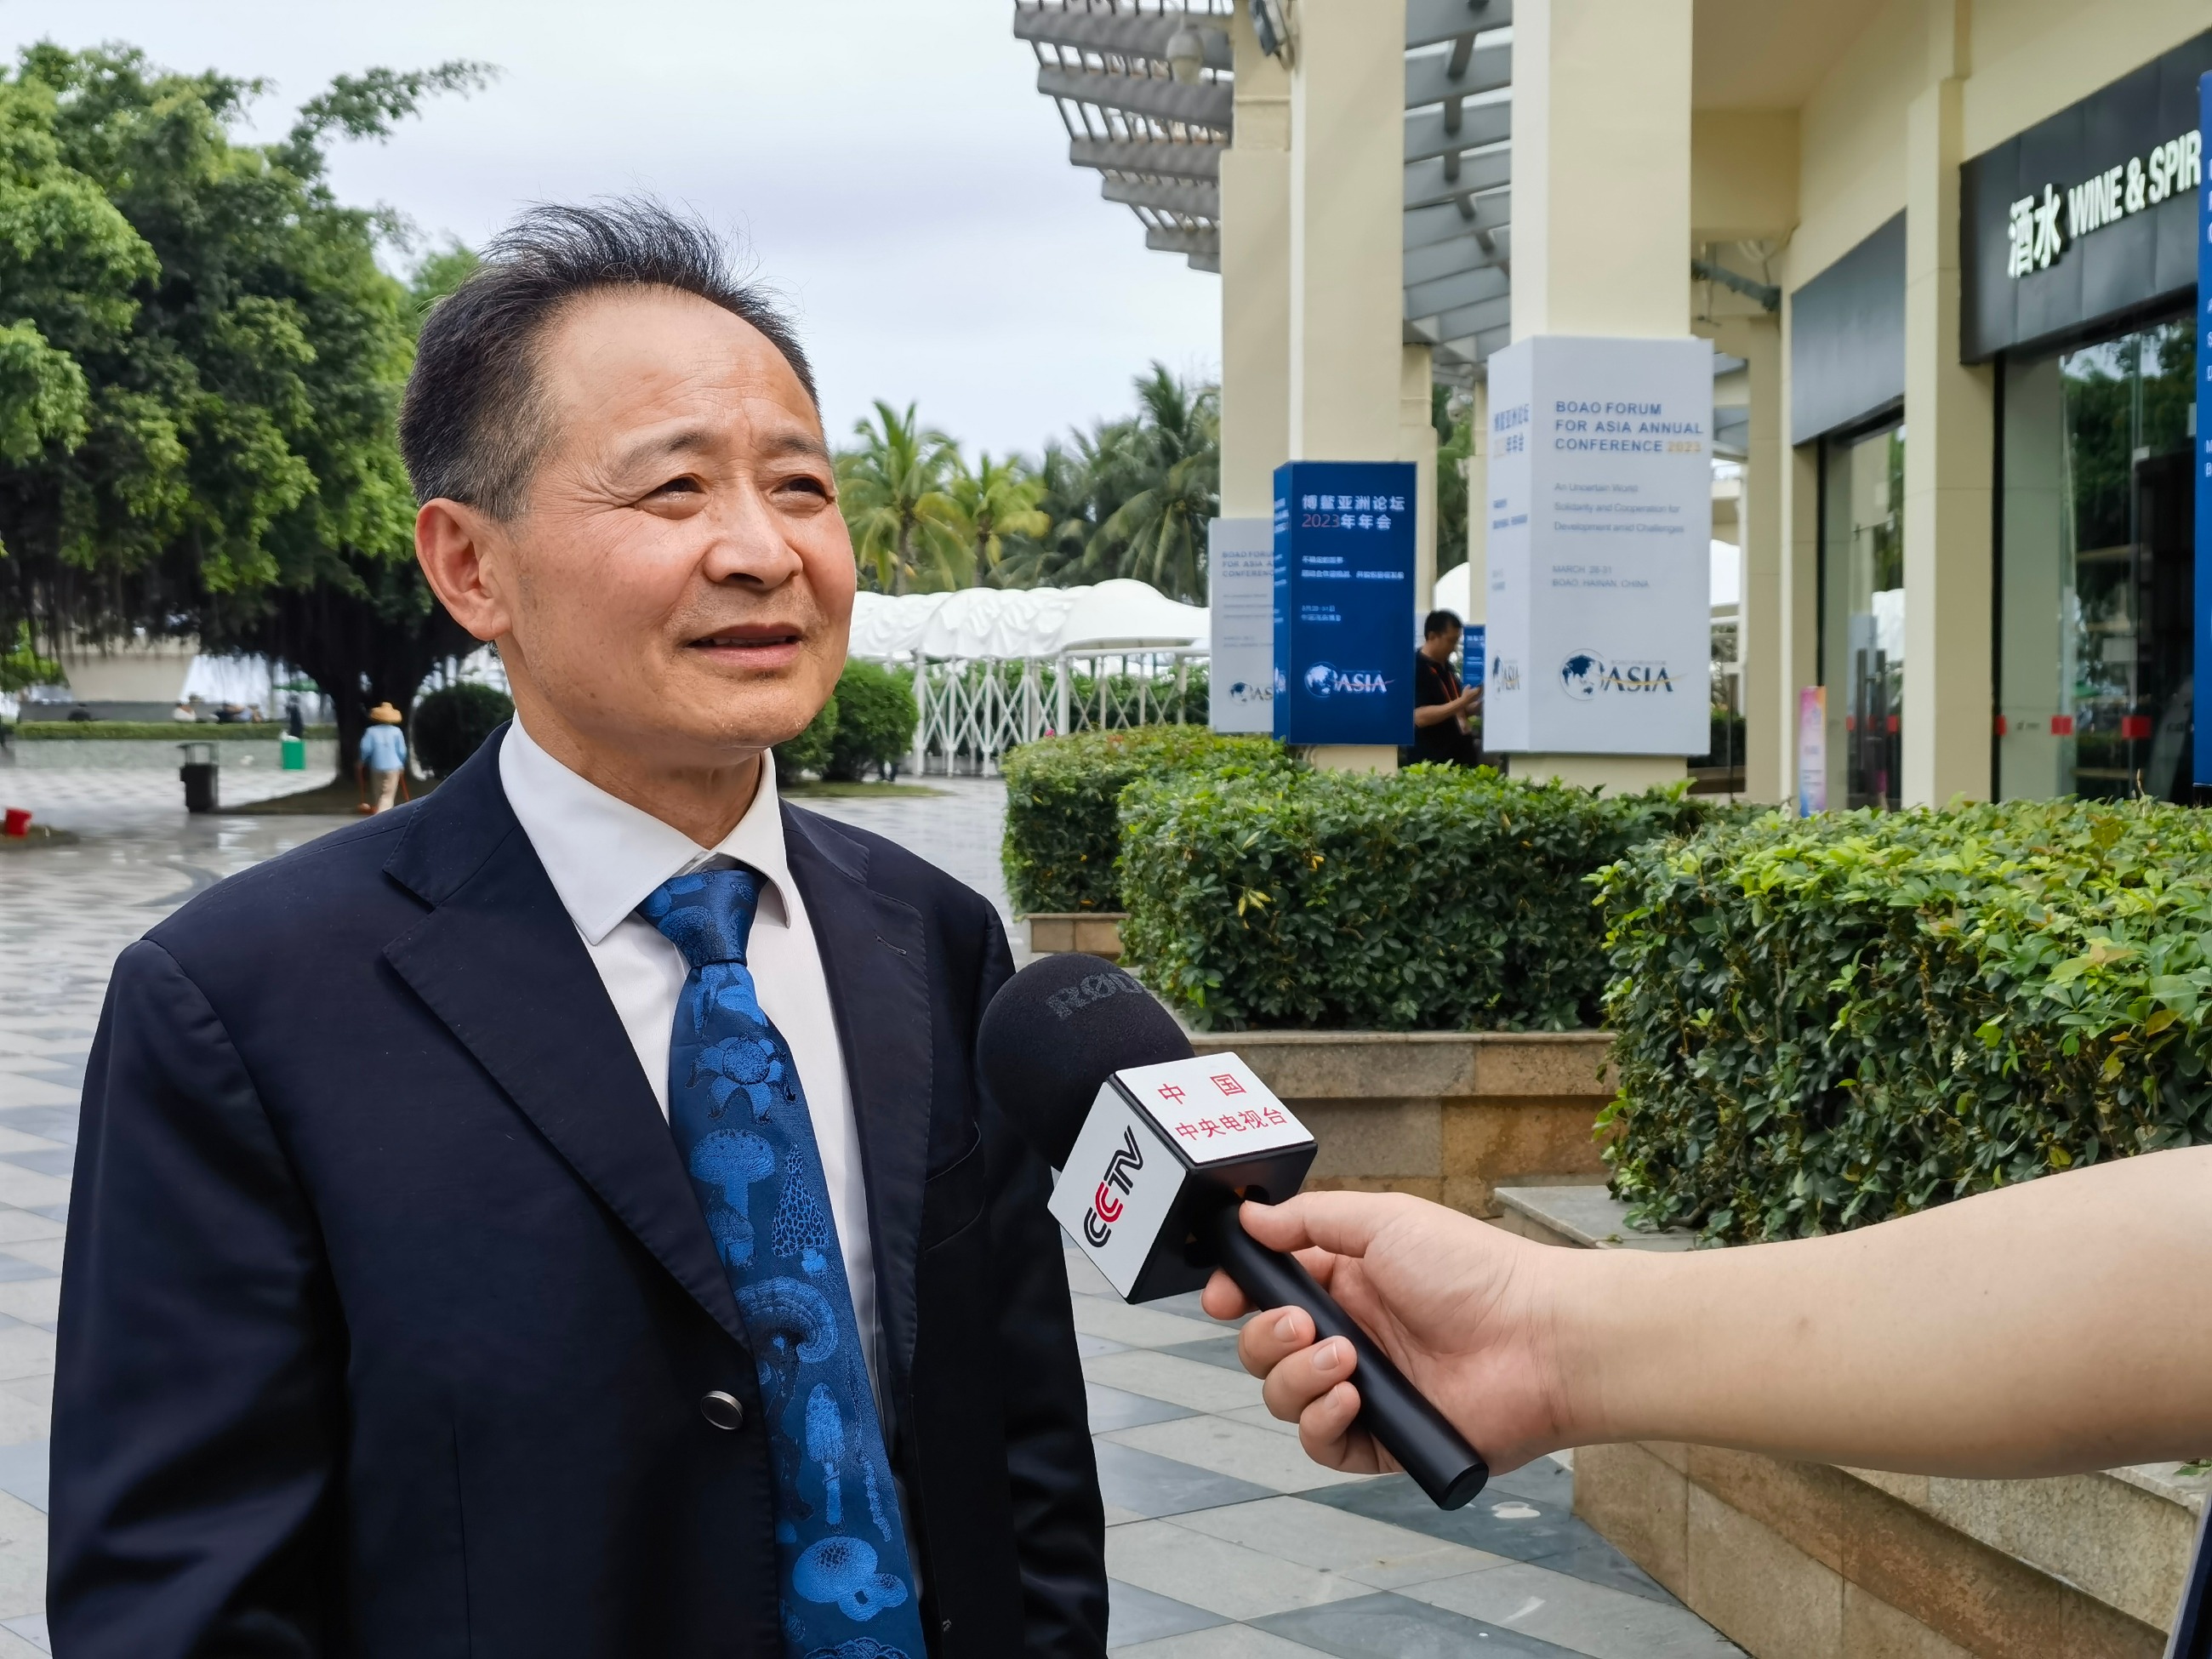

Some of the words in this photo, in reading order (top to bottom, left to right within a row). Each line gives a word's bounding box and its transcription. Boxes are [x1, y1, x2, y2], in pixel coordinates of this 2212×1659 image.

[2068, 164, 2124, 239] WINE
[2125, 157, 2146, 214] &
[2148, 129, 2202, 204] SPIR
[2008, 183, 2062, 279] 酒水
[1555, 401, 1601, 413] BOAO
[1605, 402, 1662, 414] FORUM
[1555, 419, 1588, 431] FOR
[1595, 421, 1632, 432] ASIA
[1639, 422, 1703, 434] ANNUAL
[1555, 438, 1663, 452] CONFERENCE
[1337, 673, 1387, 693] ASIA
[1603, 665, 1673, 693] ASIA
[1157, 1073, 1247, 1105] 中国
[1174, 1106, 1288, 1141] 中央电视台
[1083, 1125, 1144, 1248] CCTV
